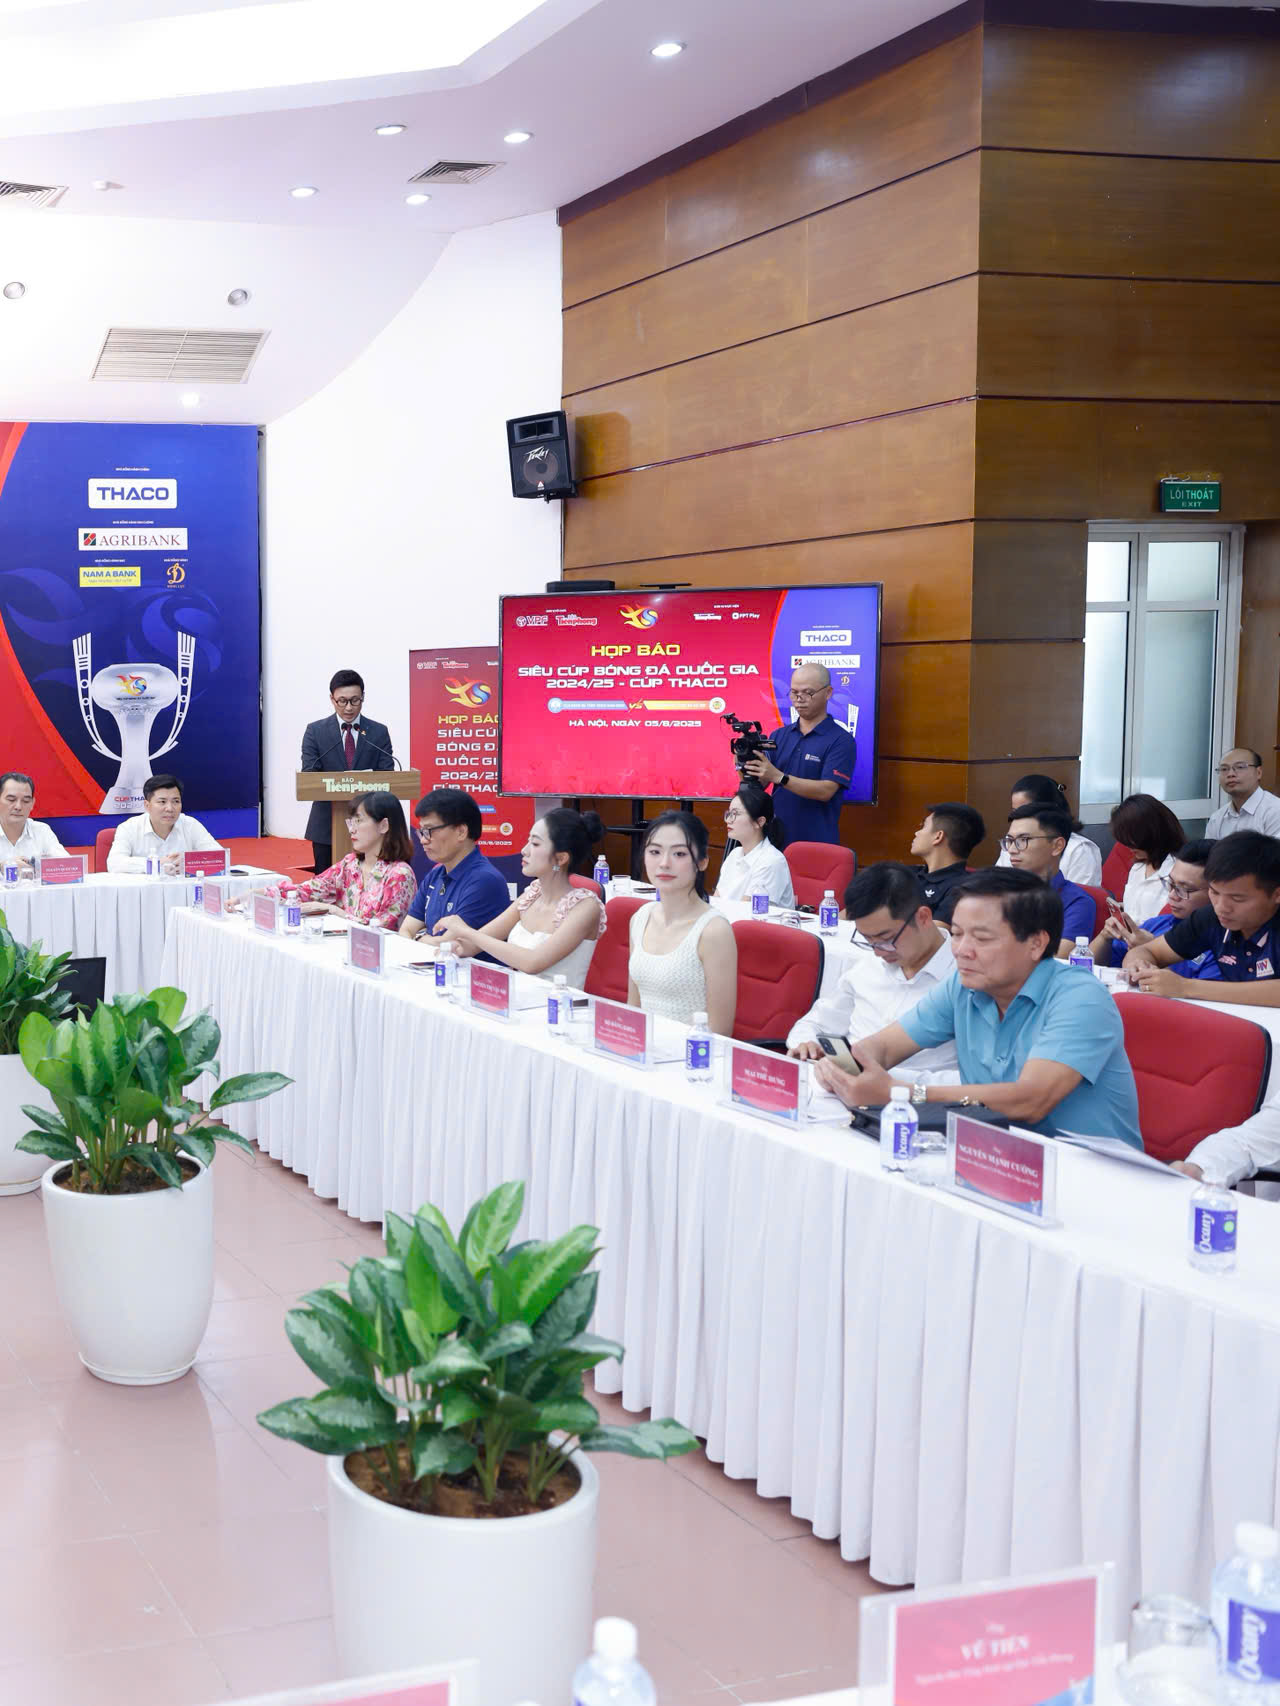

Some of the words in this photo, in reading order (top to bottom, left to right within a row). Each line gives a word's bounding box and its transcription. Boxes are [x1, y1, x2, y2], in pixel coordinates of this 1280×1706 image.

[96, 487, 169, 500] THACO
[1185, 487, 1214, 499] THOÁT
[99, 535, 181, 546] AGRIBANK
[805, 634, 847, 642] THACO
[591, 646, 631, 659] HỌP
[637, 643, 681, 656] BÁO
[518, 664, 553, 677] SIÊU
[557, 664, 589, 677] CÚP
[594, 664, 641, 676] BÓNG
[645, 663, 670, 676] ĐÁ
[676, 661, 725, 675] QUỐC
[729, 664, 759, 675] GIA
[546, 678, 614, 689] 2024/25
[629, 676, 663, 688] CÚP
[668, 678, 727, 688] THACO
[438, 715, 468, 725] HỌP
[569, 719, 584, 727] HÀ
[588, 719, 608, 728] NỘI,
[611, 719, 641, 727] NGÀY
[645, 720, 702, 728] 05/8/2025
[438, 727, 472, 738] SIÊU
[475, 727, 498, 737] CÚ
[436, 741, 480, 751] BÓNG
[484, 743, 498, 751] Đ
[435, 753, 480, 766] QUỐC
[482, 757, 497, 766] GI
[462, 784, 498, 792] THAC
[1199, 1209, 1215, 1253] Ocany
